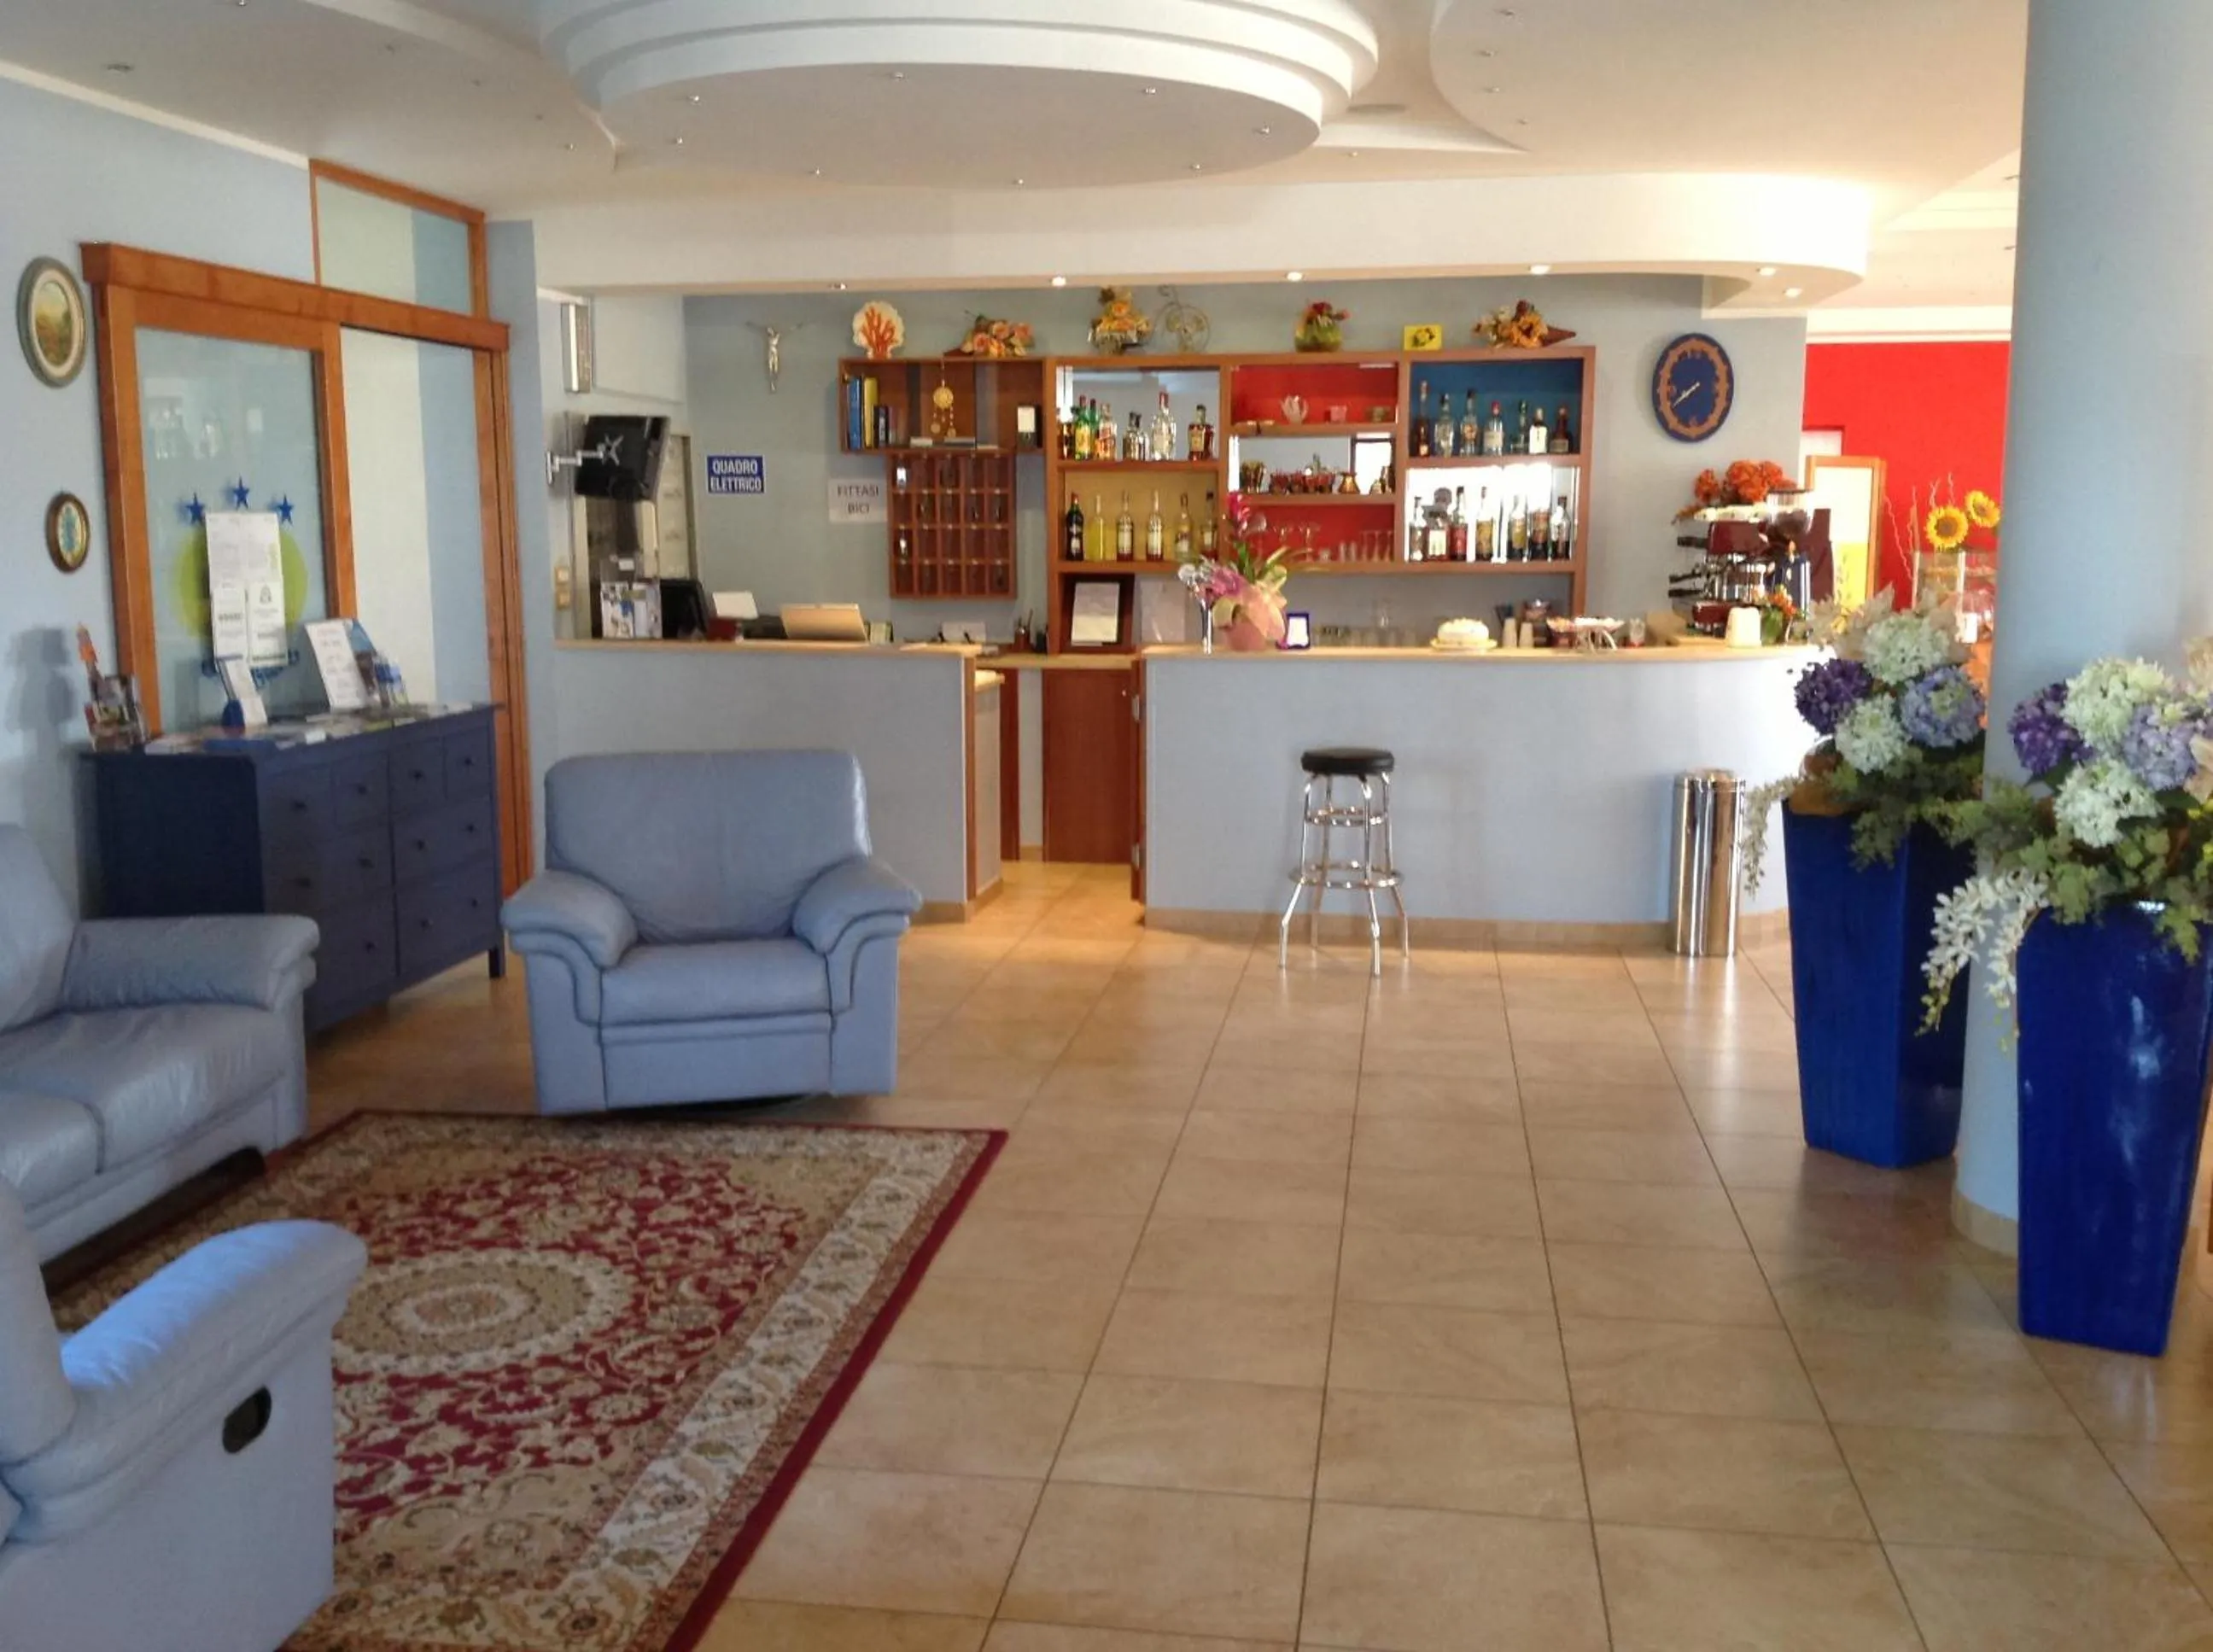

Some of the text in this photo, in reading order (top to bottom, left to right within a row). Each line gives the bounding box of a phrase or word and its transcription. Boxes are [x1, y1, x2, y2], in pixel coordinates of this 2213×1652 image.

[712, 458, 758, 475] QUADRO
[710, 476, 762, 492] ELETTRICO
[838, 484, 879, 497] FITTASI
[848, 502, 870, 514] BICI
